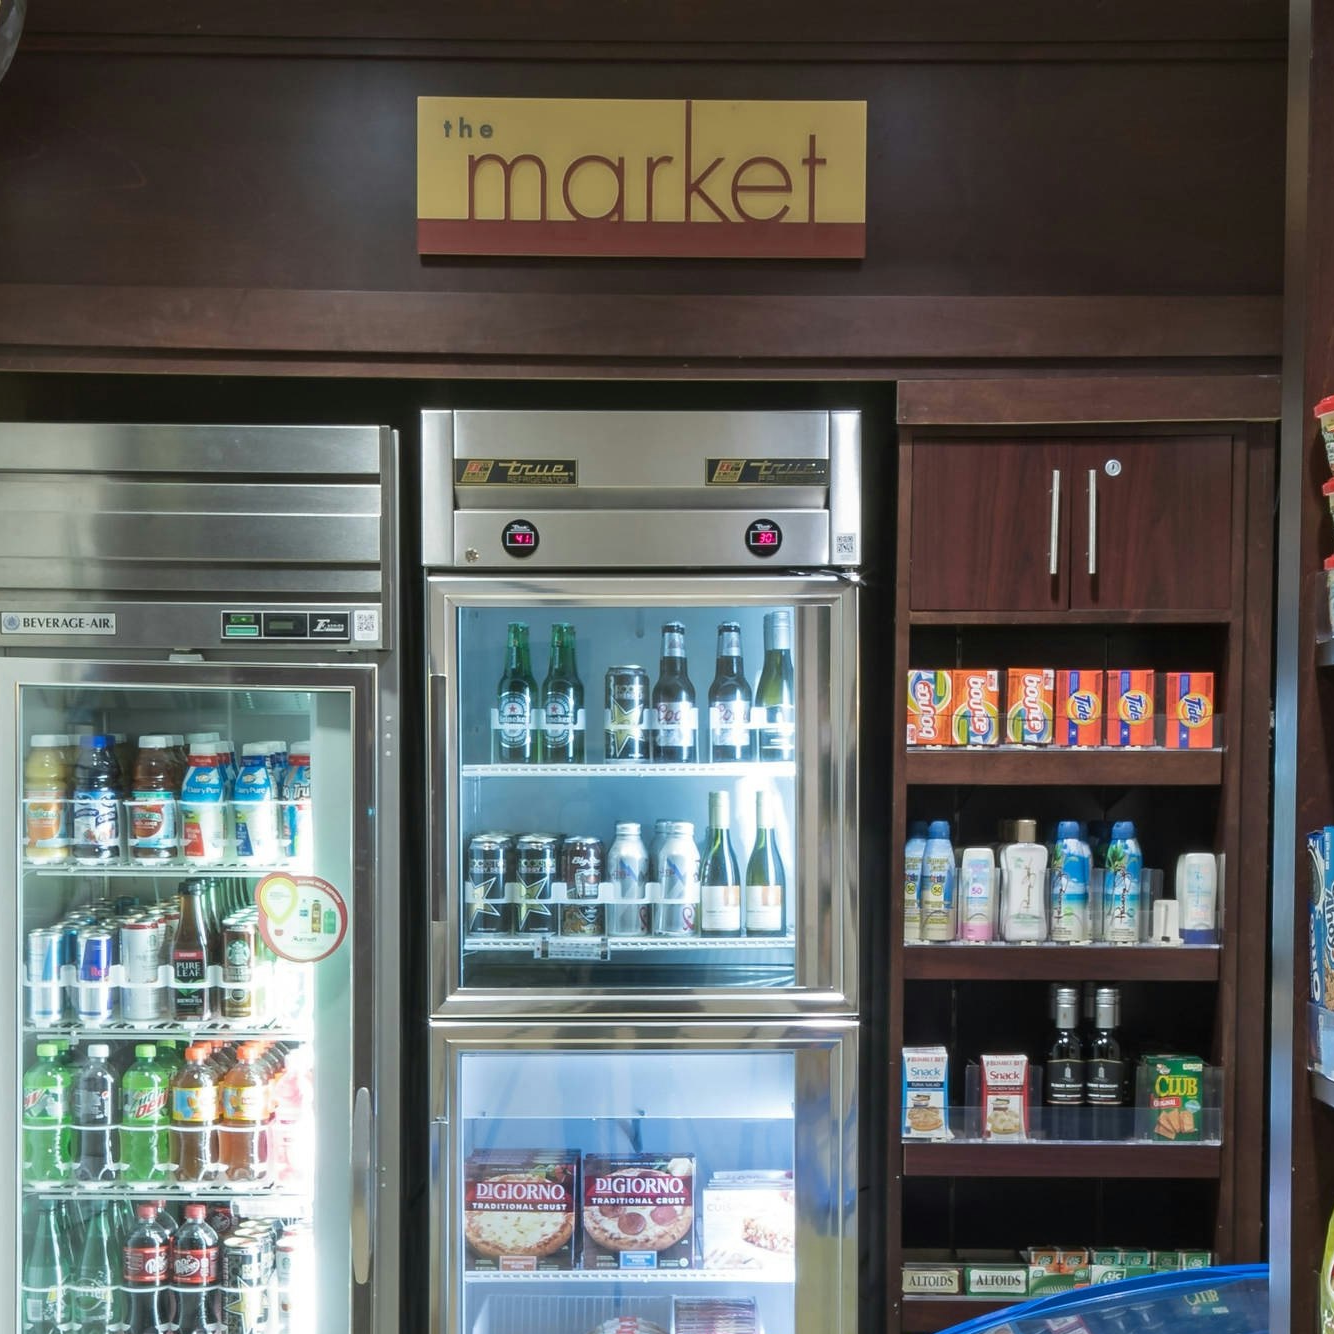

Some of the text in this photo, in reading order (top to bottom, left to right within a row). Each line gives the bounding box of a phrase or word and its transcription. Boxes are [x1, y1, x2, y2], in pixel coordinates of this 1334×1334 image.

[443, 118, 494, 139] the
[467, 99, 827, 223] market
[499, 460, 570, 477] true
[758, 532, 773, 544] 30
[22, 616, 114, 630] BEVERAGE-AIR
[967, 675, 986, 736] bounce
[1023, 673, 1043, 734] bounce
[1073, 694, 1092, 722] Tide
[1125, 694, 1143, 722] Tide
[1185, 697, 1203, 724] Tide
[970, 886, 983, 896] 50
[175, 961, 199, 972] PURE
[910, 1066, 941, 1078] Snack
[989, 1070, 1021, 1081] Snack
[1155, 1074, 1199, 1097] CLUB
[472, 1202, 567, 1211] TRADITIONAL CRUST
[591, 1196, 687, 1206] TRADITIONAL CRUST
[908, 1275, 954, 1288] ALTOIDS
[975, 1275, 1022, 1288] ALTOIDS
